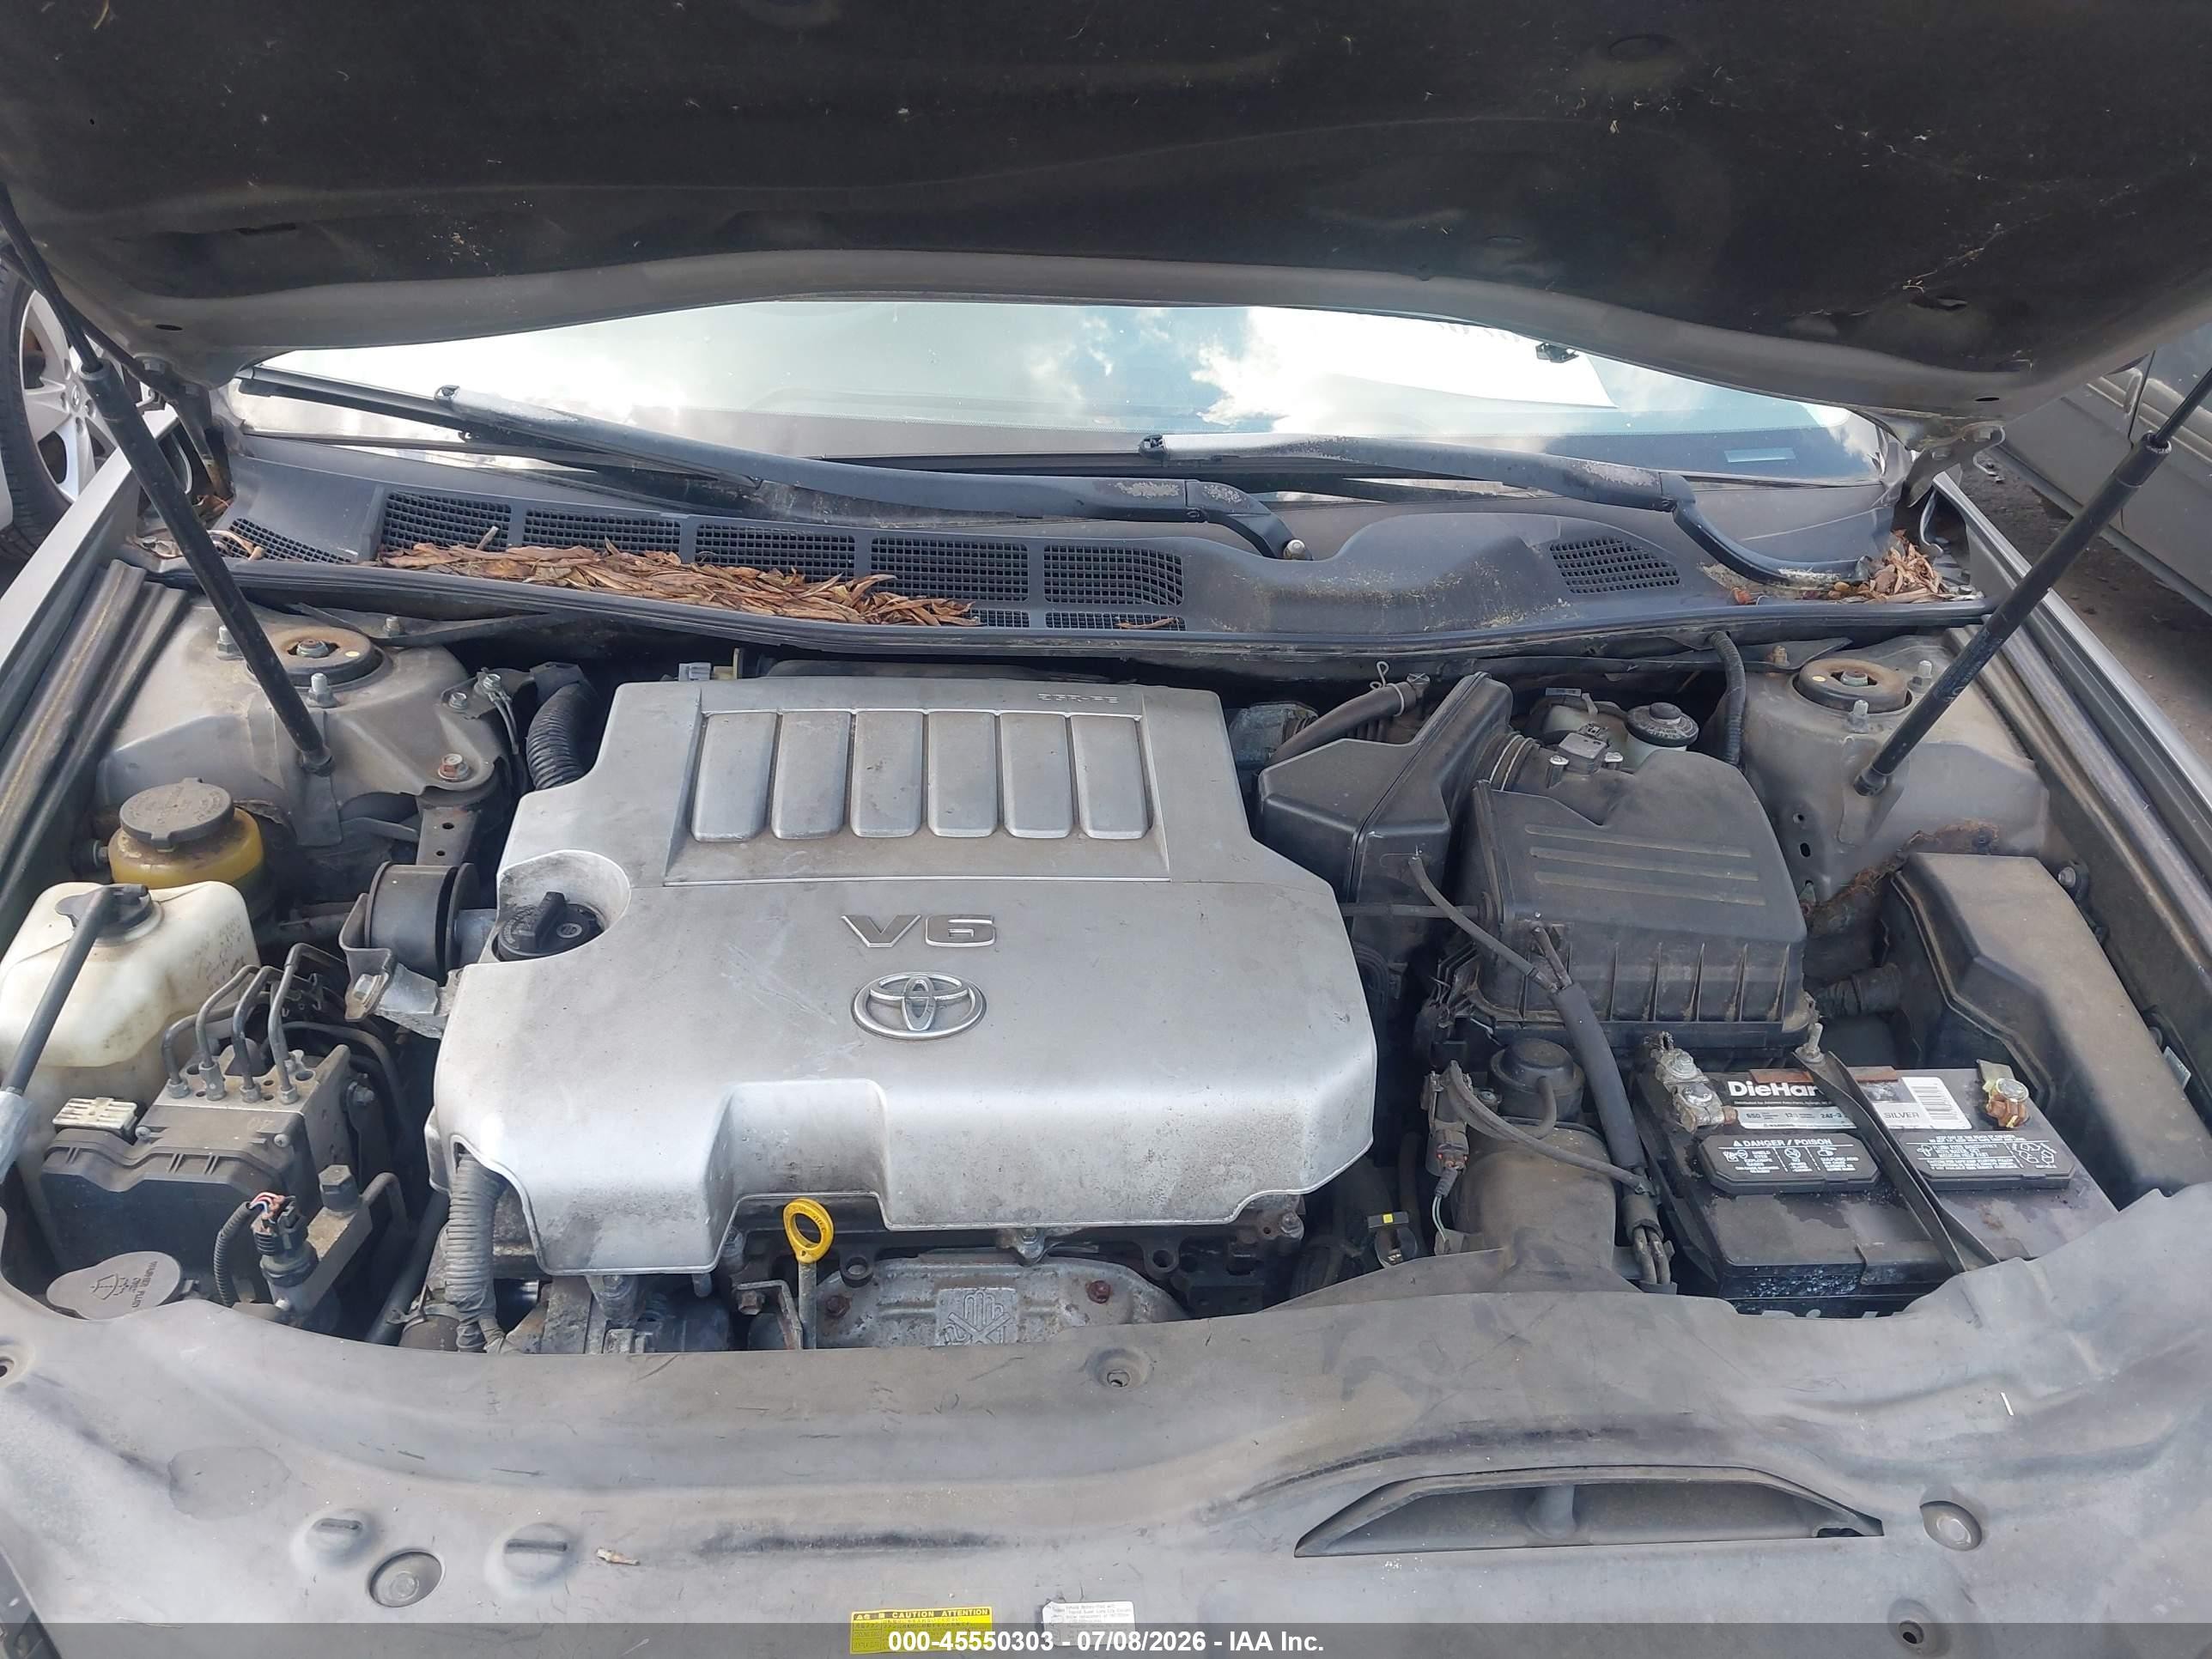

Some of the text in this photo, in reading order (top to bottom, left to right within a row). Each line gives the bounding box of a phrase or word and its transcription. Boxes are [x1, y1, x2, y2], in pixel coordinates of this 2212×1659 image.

[841, 914, 996, 948] V6
[1727, 1080, 1826, 1097] DieHar
[941, 1608, 988, 1617] ATTENTION
